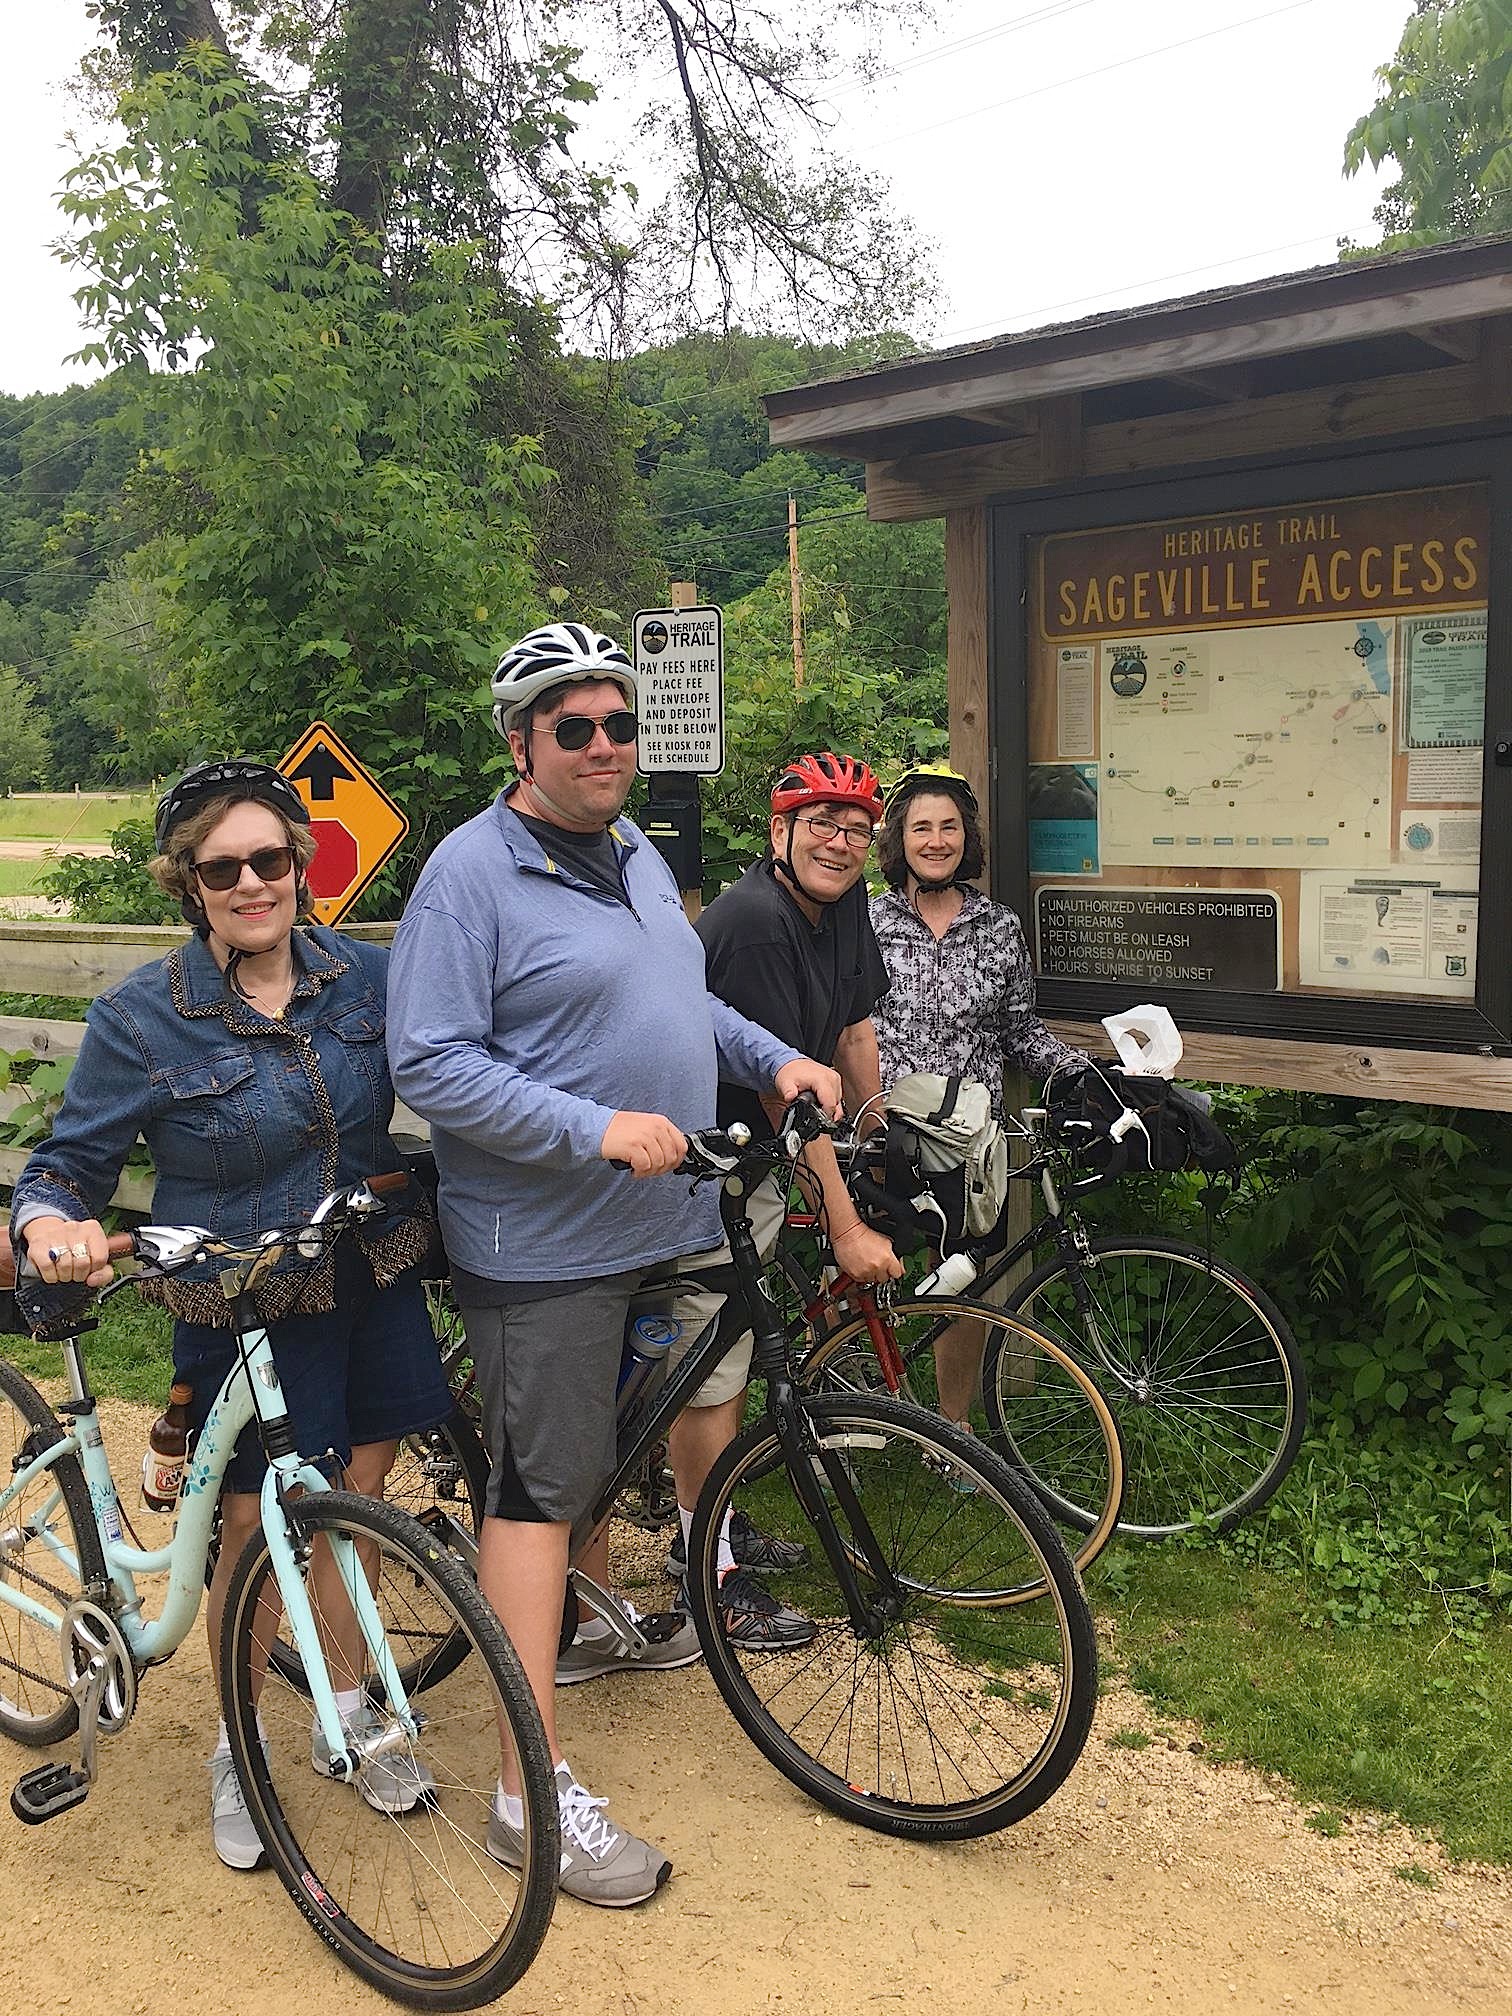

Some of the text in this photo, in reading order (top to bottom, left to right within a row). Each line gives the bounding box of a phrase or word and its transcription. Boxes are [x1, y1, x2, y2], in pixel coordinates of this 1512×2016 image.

[1164, 513, 1341, 559] HERITAGE TRAIL
[1059, 536, 1479, 626] SAGEVILLE ACCESS
[670, 621, 715, 633] HERITAGE
[670, 631, 716, 648] TRAIL
[1106, 645, 1141, 654] HERITAGE
[1113, 651, 1148, 661] TRAIL
[640, 660, 716, 675] PAY FEES HERE
[653, 678, 702, 690] PLACE FEE
[646, 693, 710, 705] IN ENVELOPE
[646, 708, 711, 719] AND DEPOSIT
[641, 723, 717, 735] IN TUBE BELOW
[647, 741, 711, 751] SEE KIOSK FOR
[649, 753, 709, 763] FEE SCHEDULE
[1048, 899, 1274, 918] UNAUTHORIZED VEHICLES PROHIBITED
[1048, 915, 1124, 929] NO FIREARMS
[1049, 930, 1190, 948] PETS MUST BE ON LEASH
[1050, 945, 1172, 963] NO HORSES ALLOWED
[1094, 963, 1144, 977] SUNRISE
[1147, 965, 1162, 978] TO
[1165, 966, 1214, 981] SUNSET
